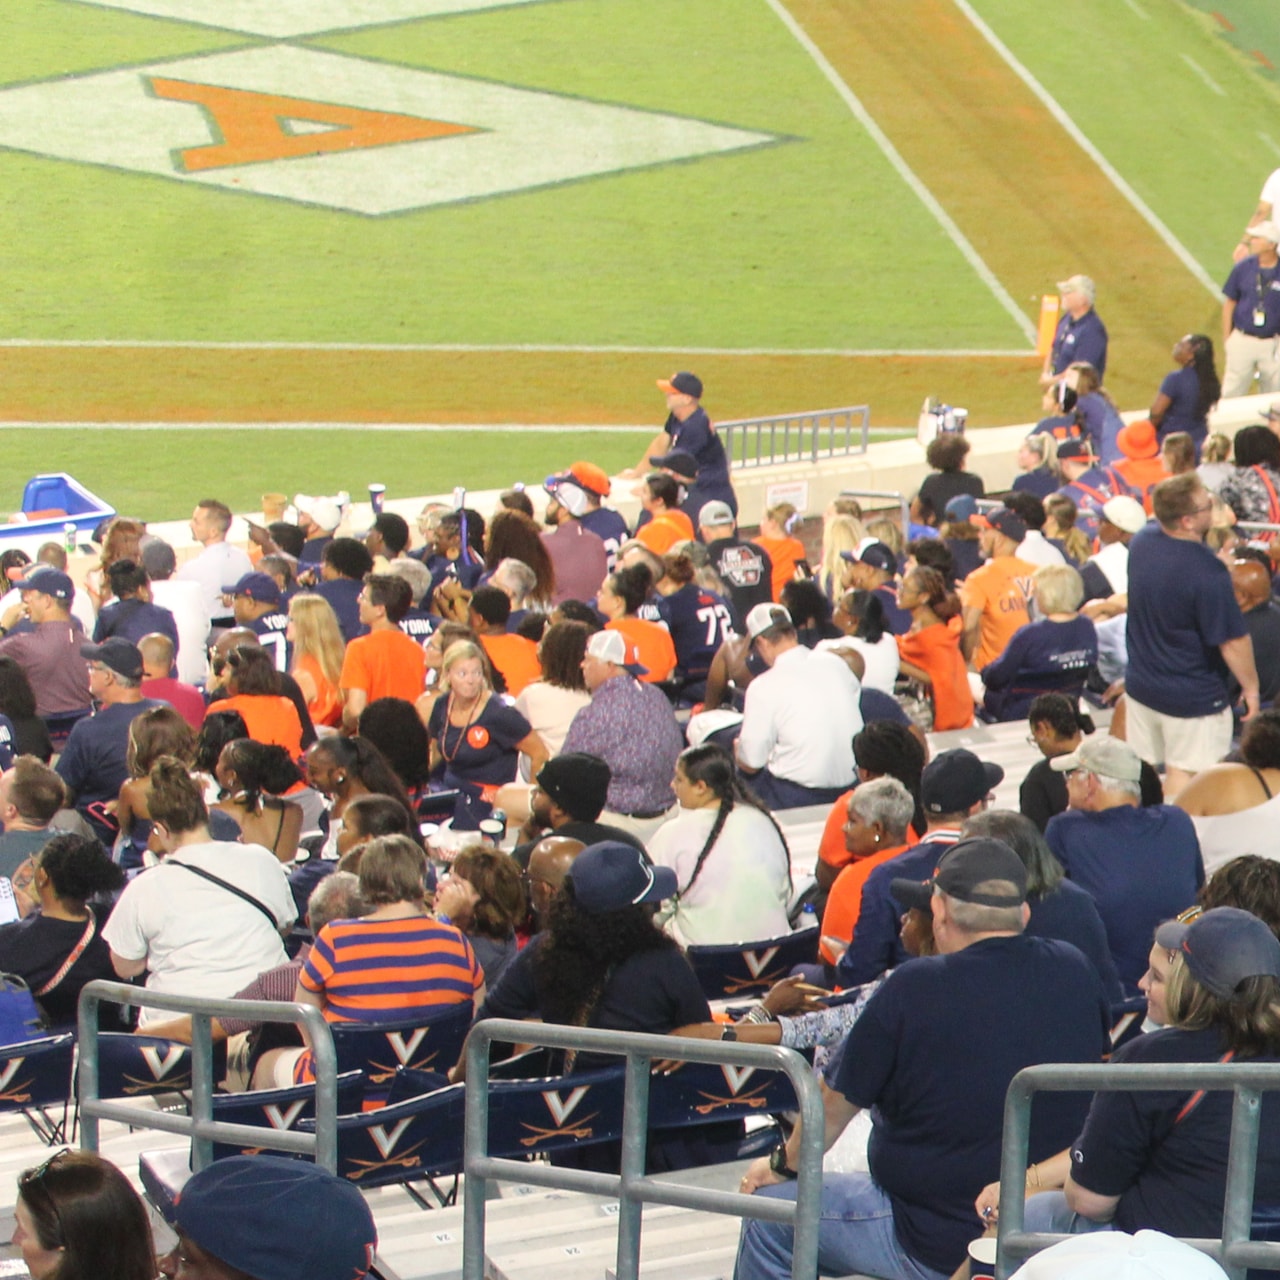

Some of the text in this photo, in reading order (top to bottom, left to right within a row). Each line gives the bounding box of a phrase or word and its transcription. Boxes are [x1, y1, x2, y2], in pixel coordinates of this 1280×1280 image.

[142, 74, 492, 173] A
[398, 618, 433, 635] YORK
[259, 630, 286, 673] 7
[742, 945, 780, 980] V
[139, 1046, 186, 1081] V
[385, 1026, 430, 1067] V
[541, 1084, 591, 1128] V
[366, 1115, 417, 1160] V
